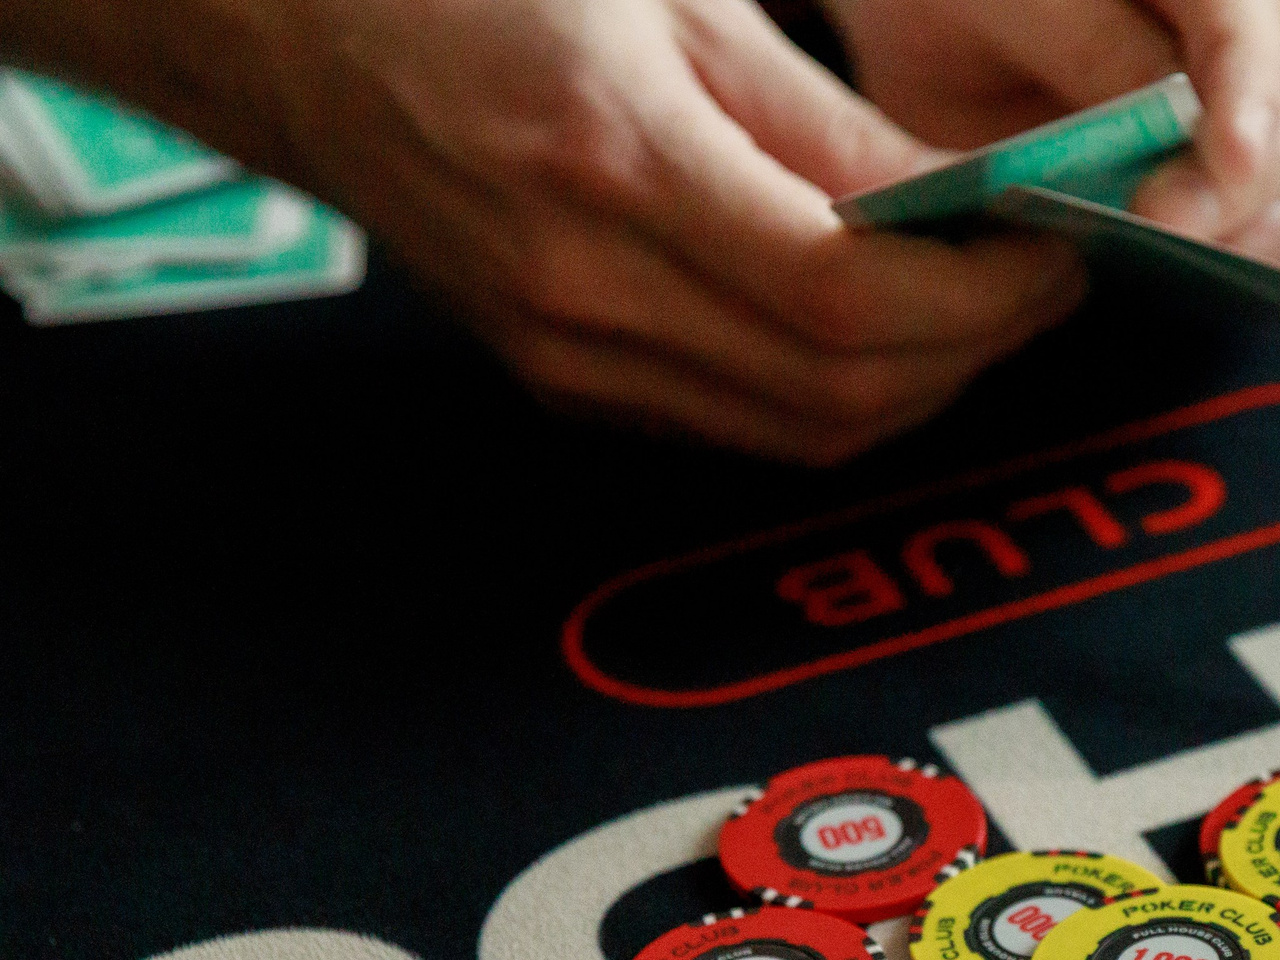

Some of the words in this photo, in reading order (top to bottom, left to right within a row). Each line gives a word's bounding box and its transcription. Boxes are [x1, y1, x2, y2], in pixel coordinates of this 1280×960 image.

[777, 458, 1227, 626] CLUB
[817, 815, 887, 851] 500
[672, 926, 740, 958] CLUB
[936, 917, 959, 960] CLUB
[1122, 900, 1214, 918] POKER
[1219, 908, 1272, 946] CLUB
[1132, 928, 1165, 939] FULL
[1168, 927, 1213, 940] HOUSE
[1212, 938, 1233, 958] CLUB
